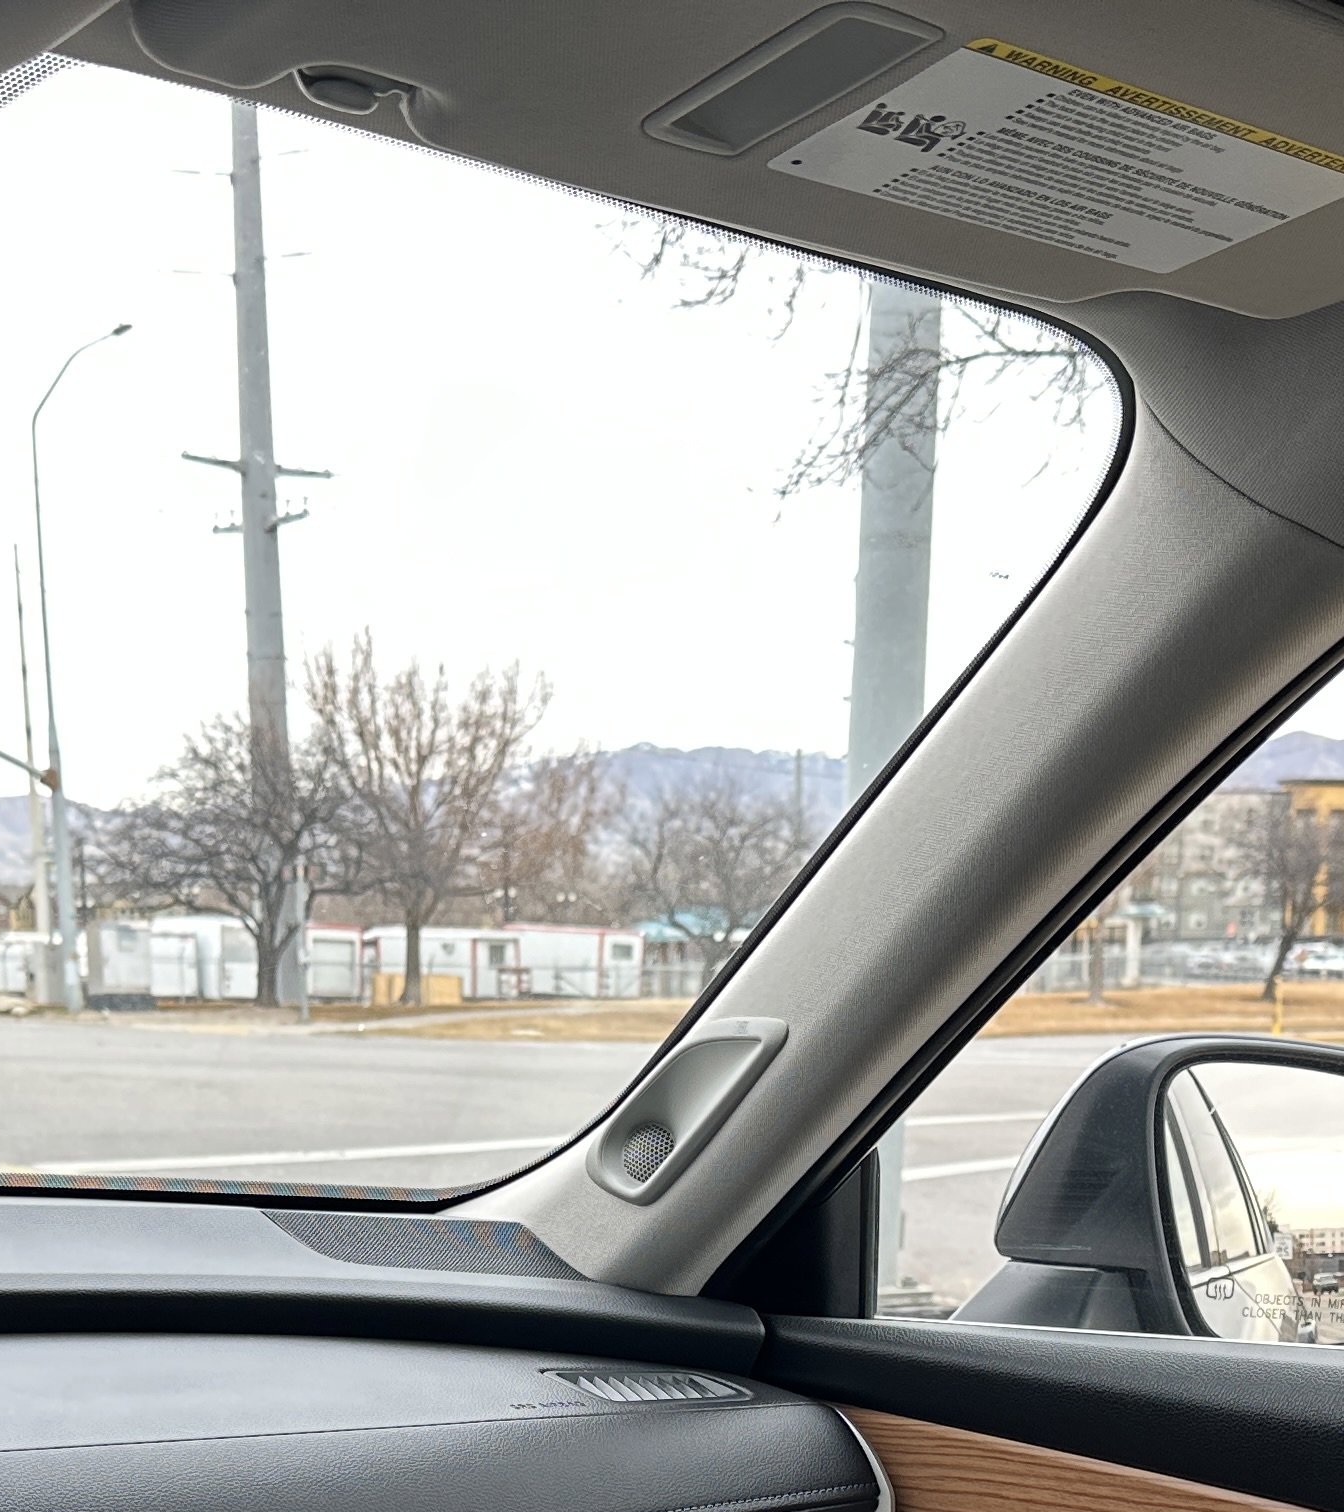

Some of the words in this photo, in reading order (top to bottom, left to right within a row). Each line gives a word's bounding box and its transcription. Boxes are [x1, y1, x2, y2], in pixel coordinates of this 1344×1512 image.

[1006, 50, 1097, 86] WARNING
[1105, 85, 1256, 138] AVERTISSEMENT
[1256, 1293, 1304, 1307] OBJECTS
[1311, 1297, 1321, 1308] IN
[1242, 1306, 1286, 1320] CLOSER
[1294, 1310, 1322, 1321] THAN
